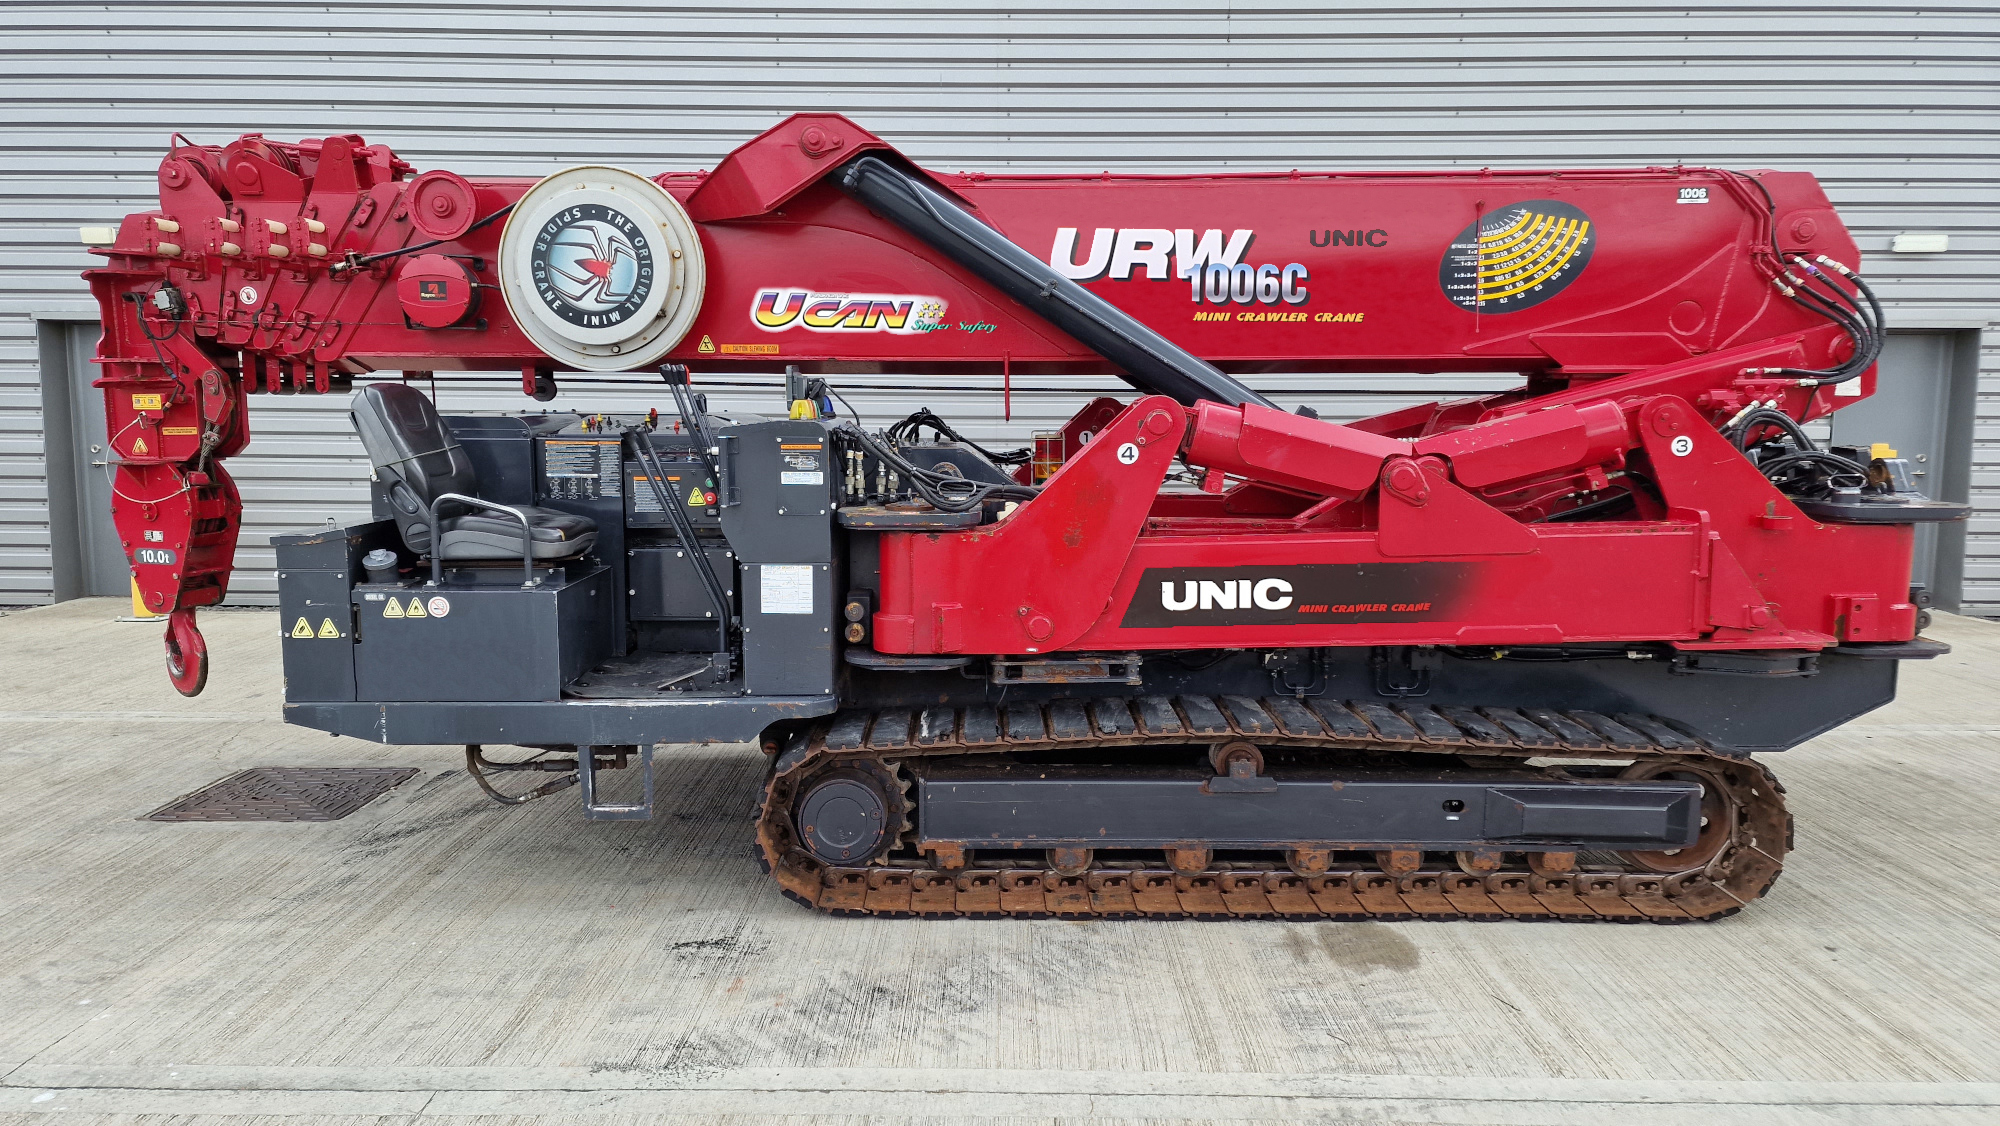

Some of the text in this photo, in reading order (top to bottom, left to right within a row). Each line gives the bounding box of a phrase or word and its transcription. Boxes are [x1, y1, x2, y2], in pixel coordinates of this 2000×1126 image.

[1680, 188, 1706, 198] 1006
[1310, 229, 1388, 247] UNIC
[534, 208, 581, 310] SPIDER CRANE
[1050, 227, 1254, 281] URW
[583, 210, 652, 326] THE ORIGINAL MINI
[1184, 263, 1309, 304] 1006C
[755, 292, 913, 328] UCAN
[1193, 312, 1364, 323] MINI CRAWLER CRANE
[911, 319, 997, 334] Super Safety
[1084, 433, 1088, 443] 1
[1676, 439, 1688, 453] 3
[1121, 447, 1134, 460] 4
[141, 550, 170, 564] 10.0t
[1161, 578, 1431, 612] UNIC MINI CRAWLER CRANE
